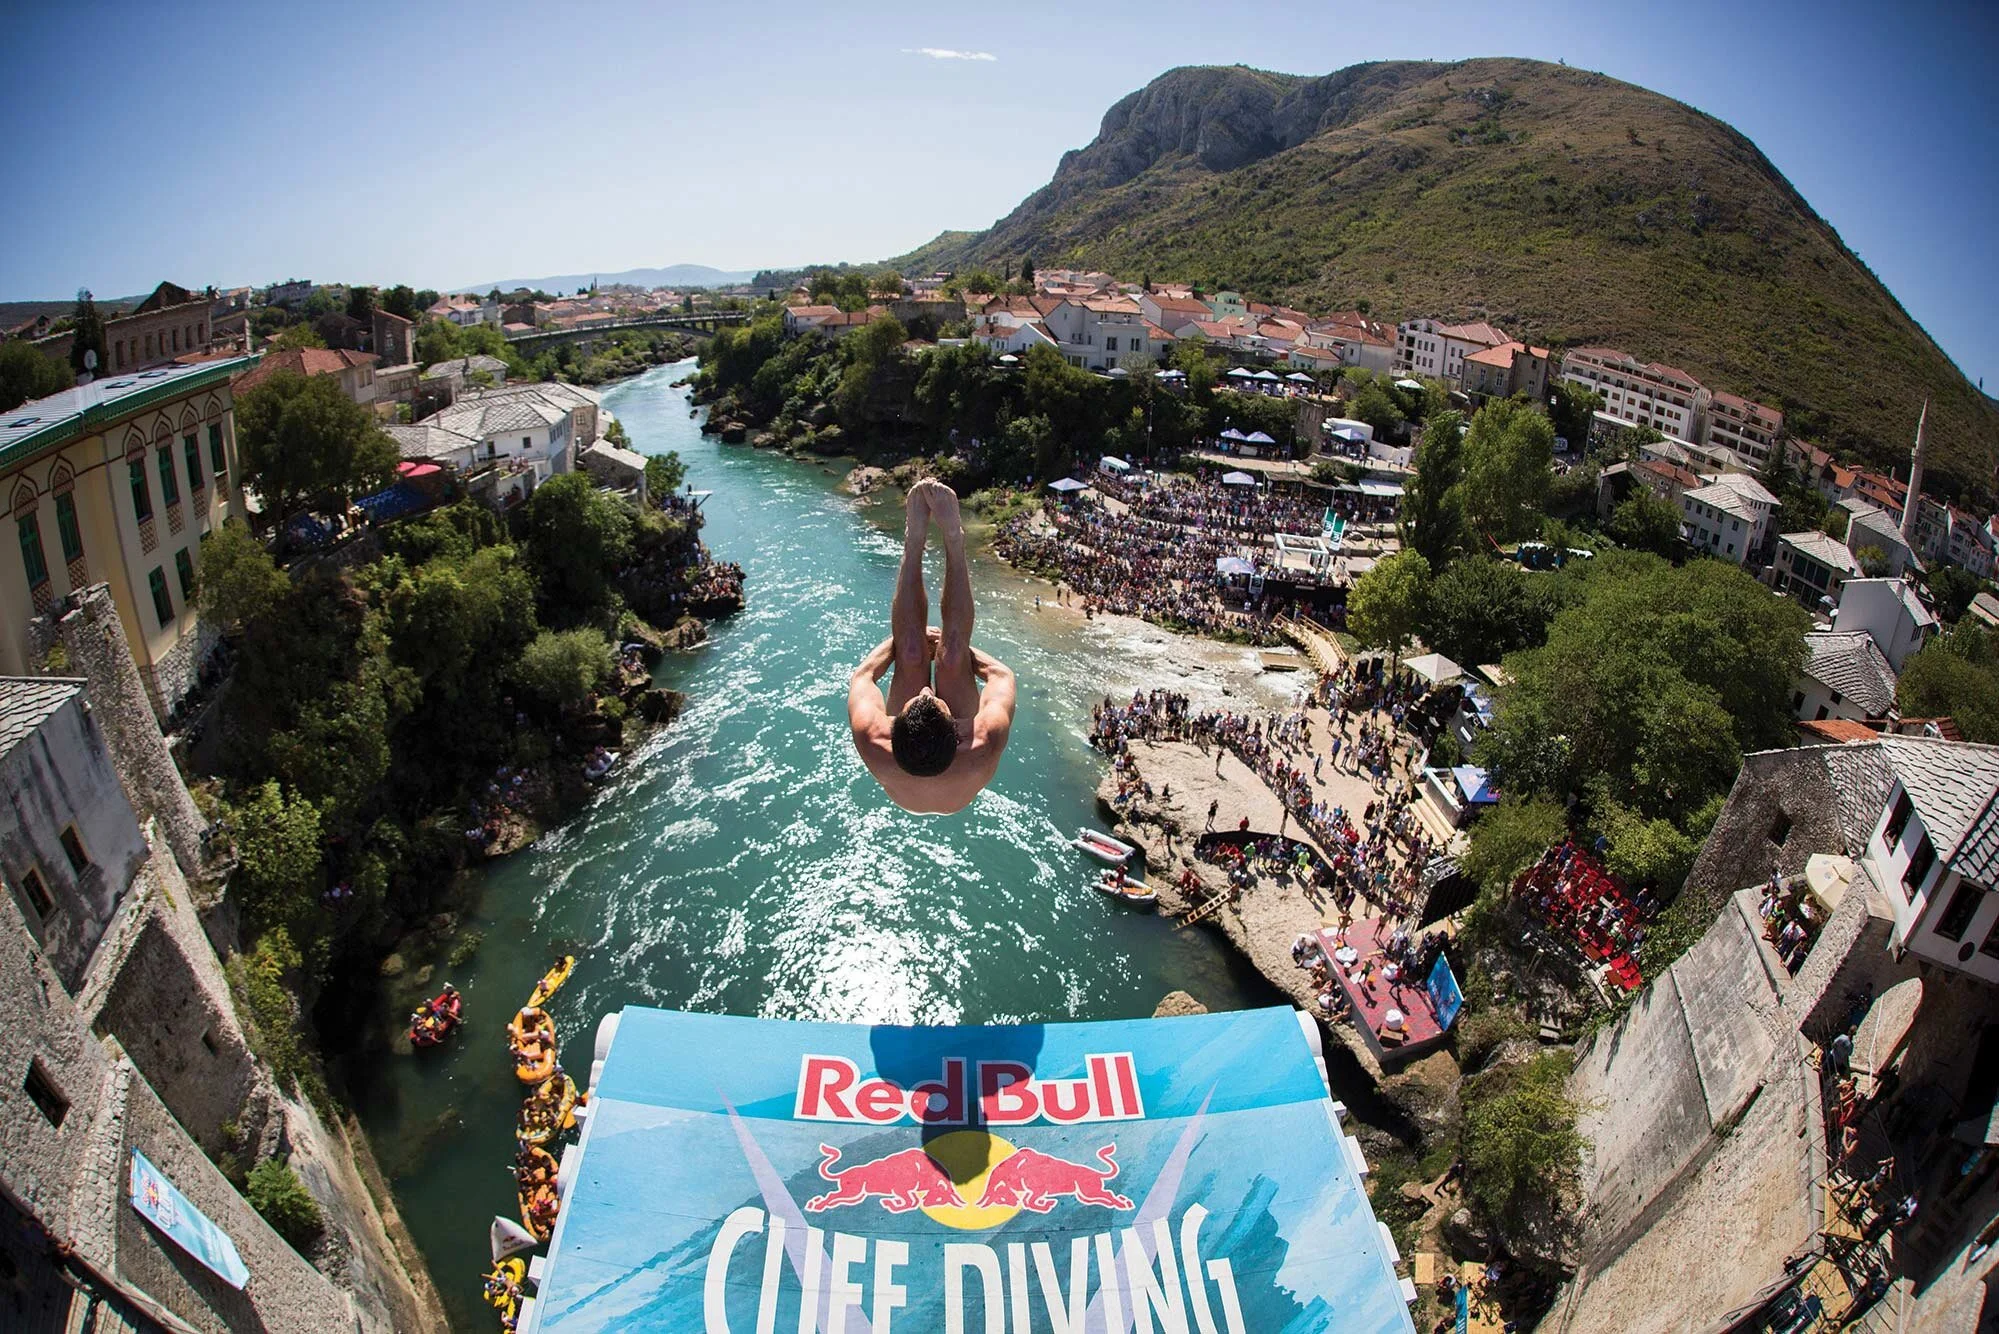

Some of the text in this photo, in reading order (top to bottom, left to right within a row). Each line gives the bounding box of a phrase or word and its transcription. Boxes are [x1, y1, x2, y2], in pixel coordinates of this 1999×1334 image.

[798, 1054, 1141, 1122] Red Bull
[944, 1202, 1246, 1334] DIVING
